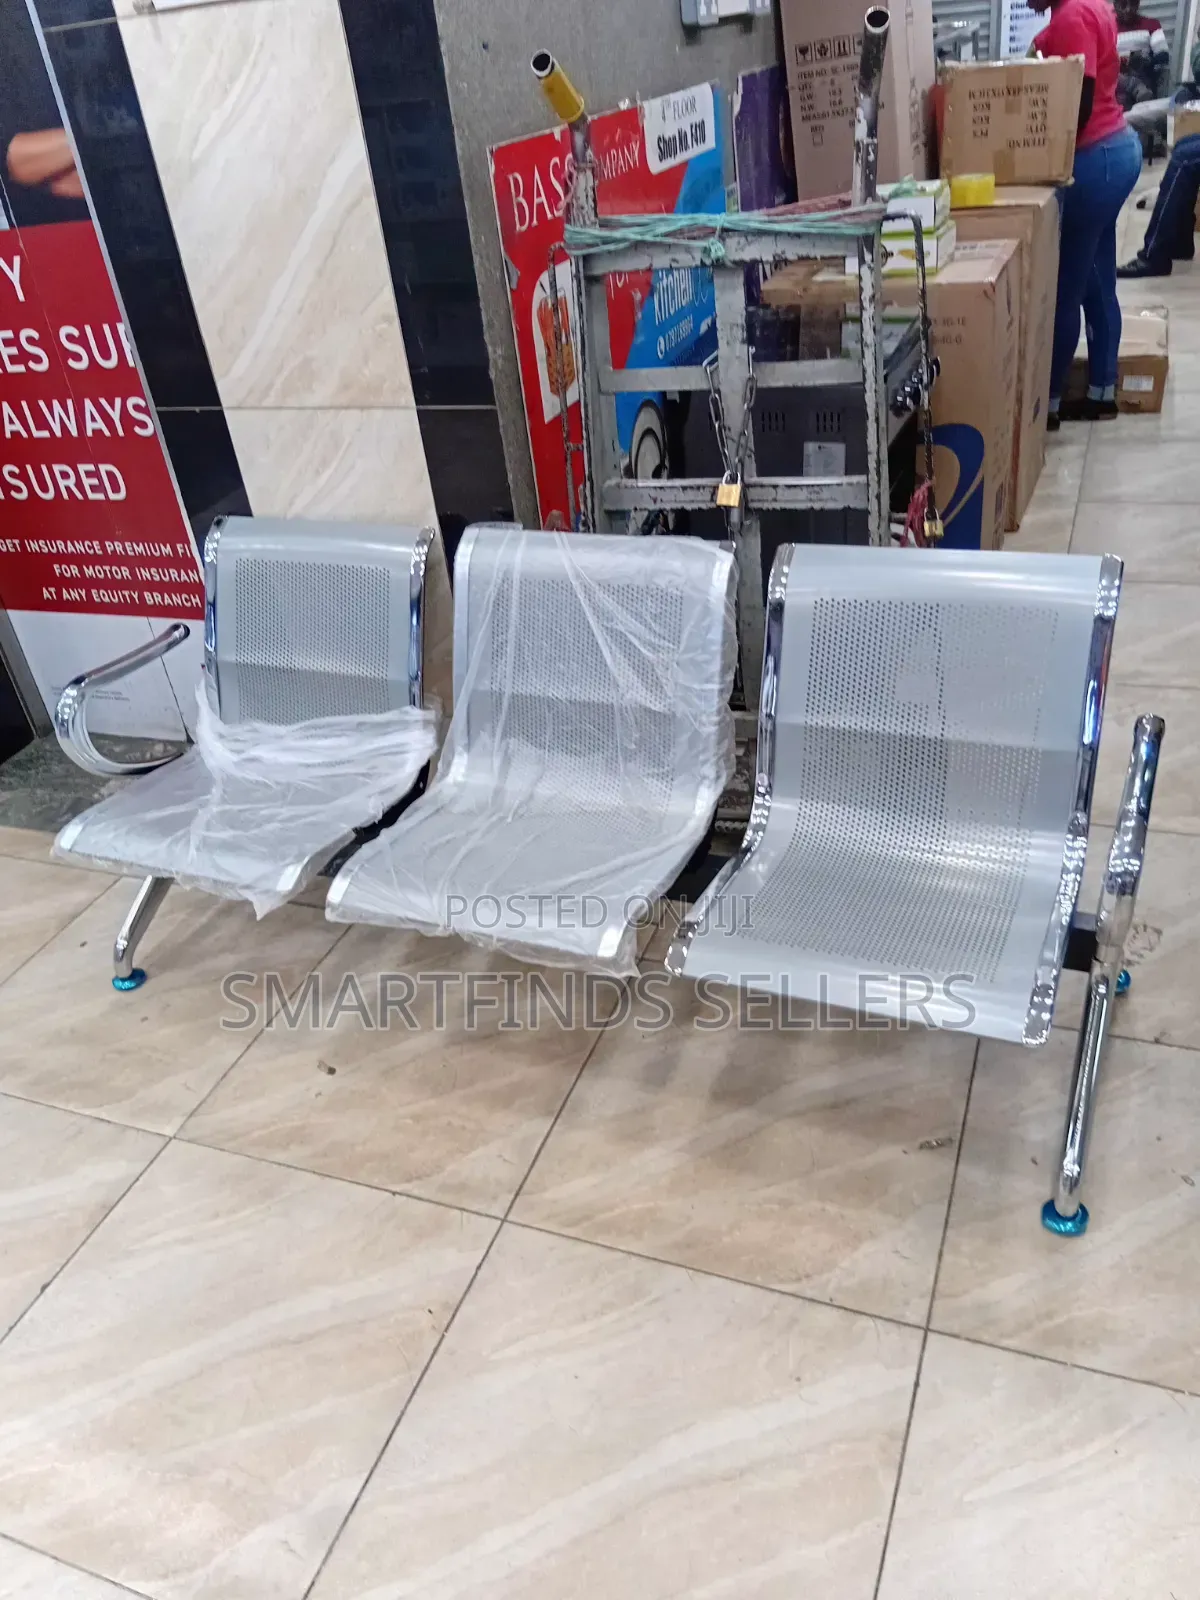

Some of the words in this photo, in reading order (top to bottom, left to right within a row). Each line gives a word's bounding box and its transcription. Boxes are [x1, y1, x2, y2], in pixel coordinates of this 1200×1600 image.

[672, 95, 697, 121] FLOOR
[657, 133, 678, 163] Shop
[678, 127, 690, 153] No.
[690, 118, 706, 149] F410
[0, 328, 49, 373] ES
[2, 396, 155, 439] ALWAYS
[0, 464, 126, 500] SURED
[0, 539, 21, 552] GET
[25, 539, 102, 555] INSURANCE
[105, 541, 174, 558] PREMIUM
[53, 564, 81, 578] FOR
[83, 565, 132, 580] MOTOR
[42, 587, 57, 600] AT
[62, 587, 87, 602] ANY
[91, 588, 140, 605] EQUITY
[144, 591, 202, 608] BRANCH
